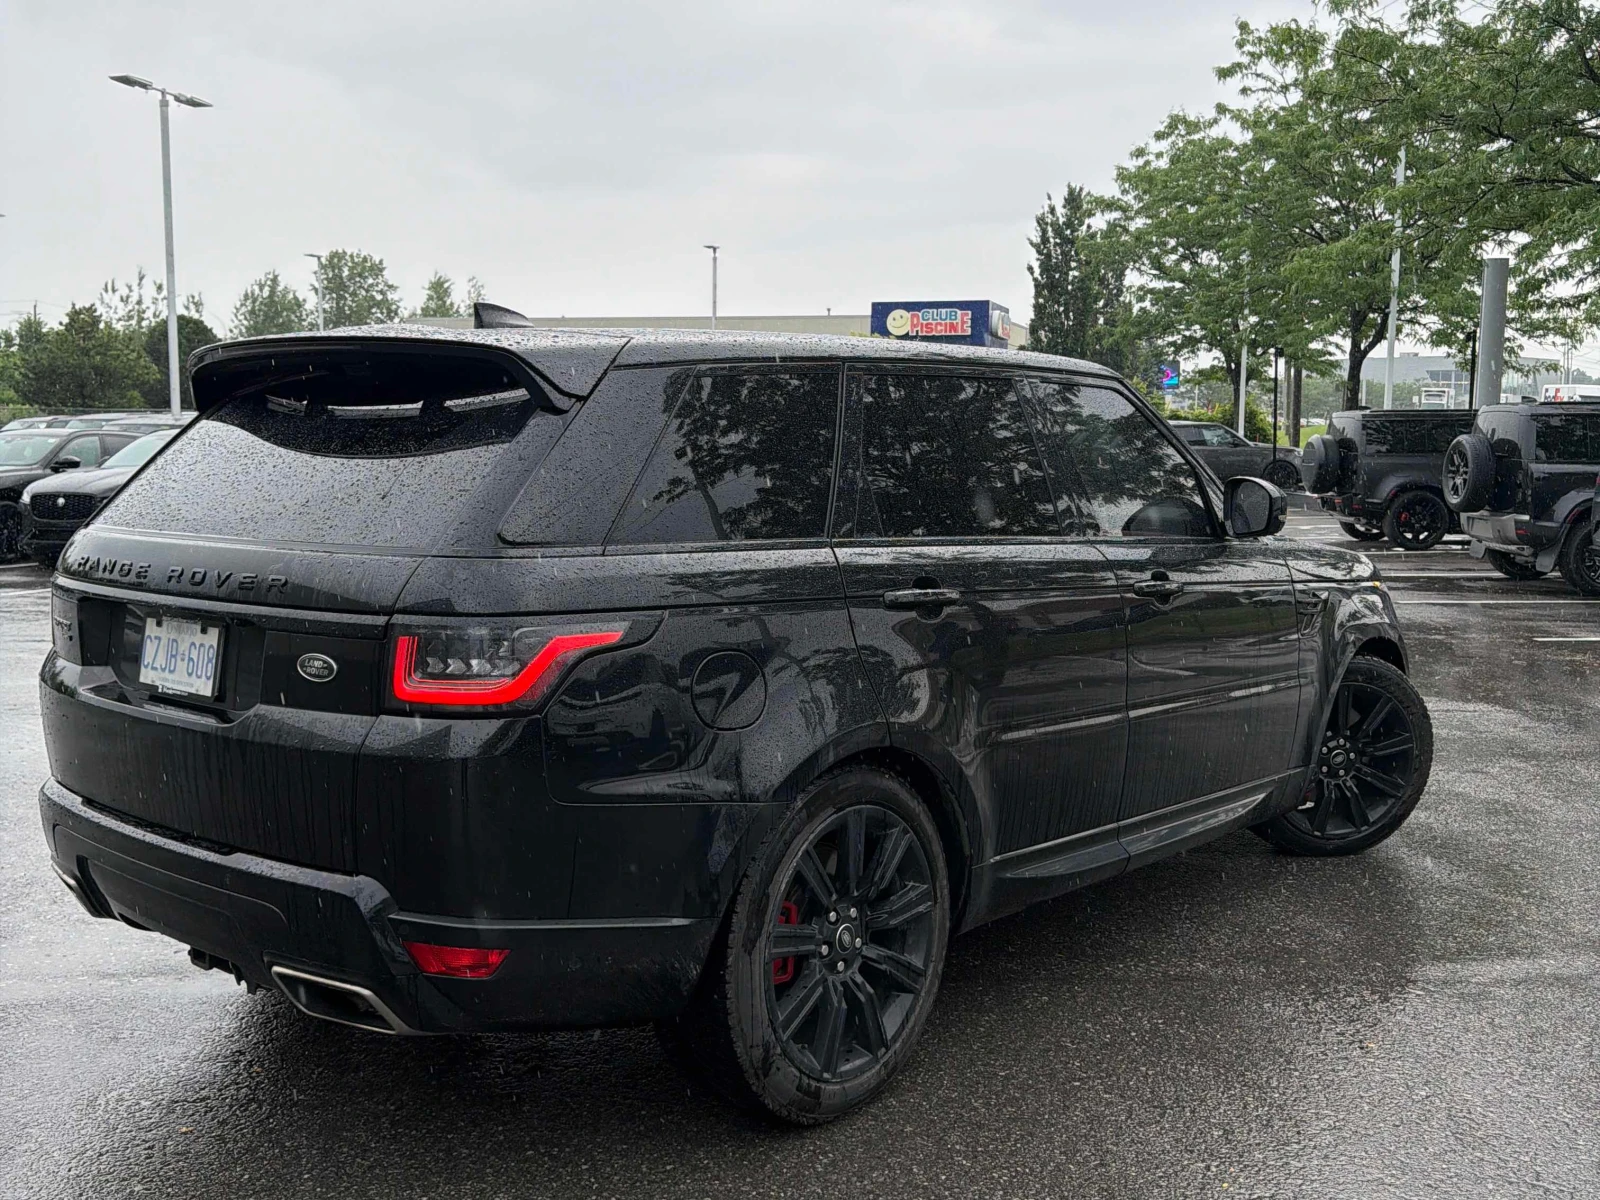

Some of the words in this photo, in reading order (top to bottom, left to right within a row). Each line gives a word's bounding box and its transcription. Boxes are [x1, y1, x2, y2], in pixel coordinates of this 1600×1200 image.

[921, 310, 958, 321] CLUB
[910, 311, 971, 335] PISCINE
[76, 555, 151, 581] RANGE
[166, 565, 289, 594] ROVER
[304, 658, 324, 668] LAND
[306, 666, 329, 677] ROVER
